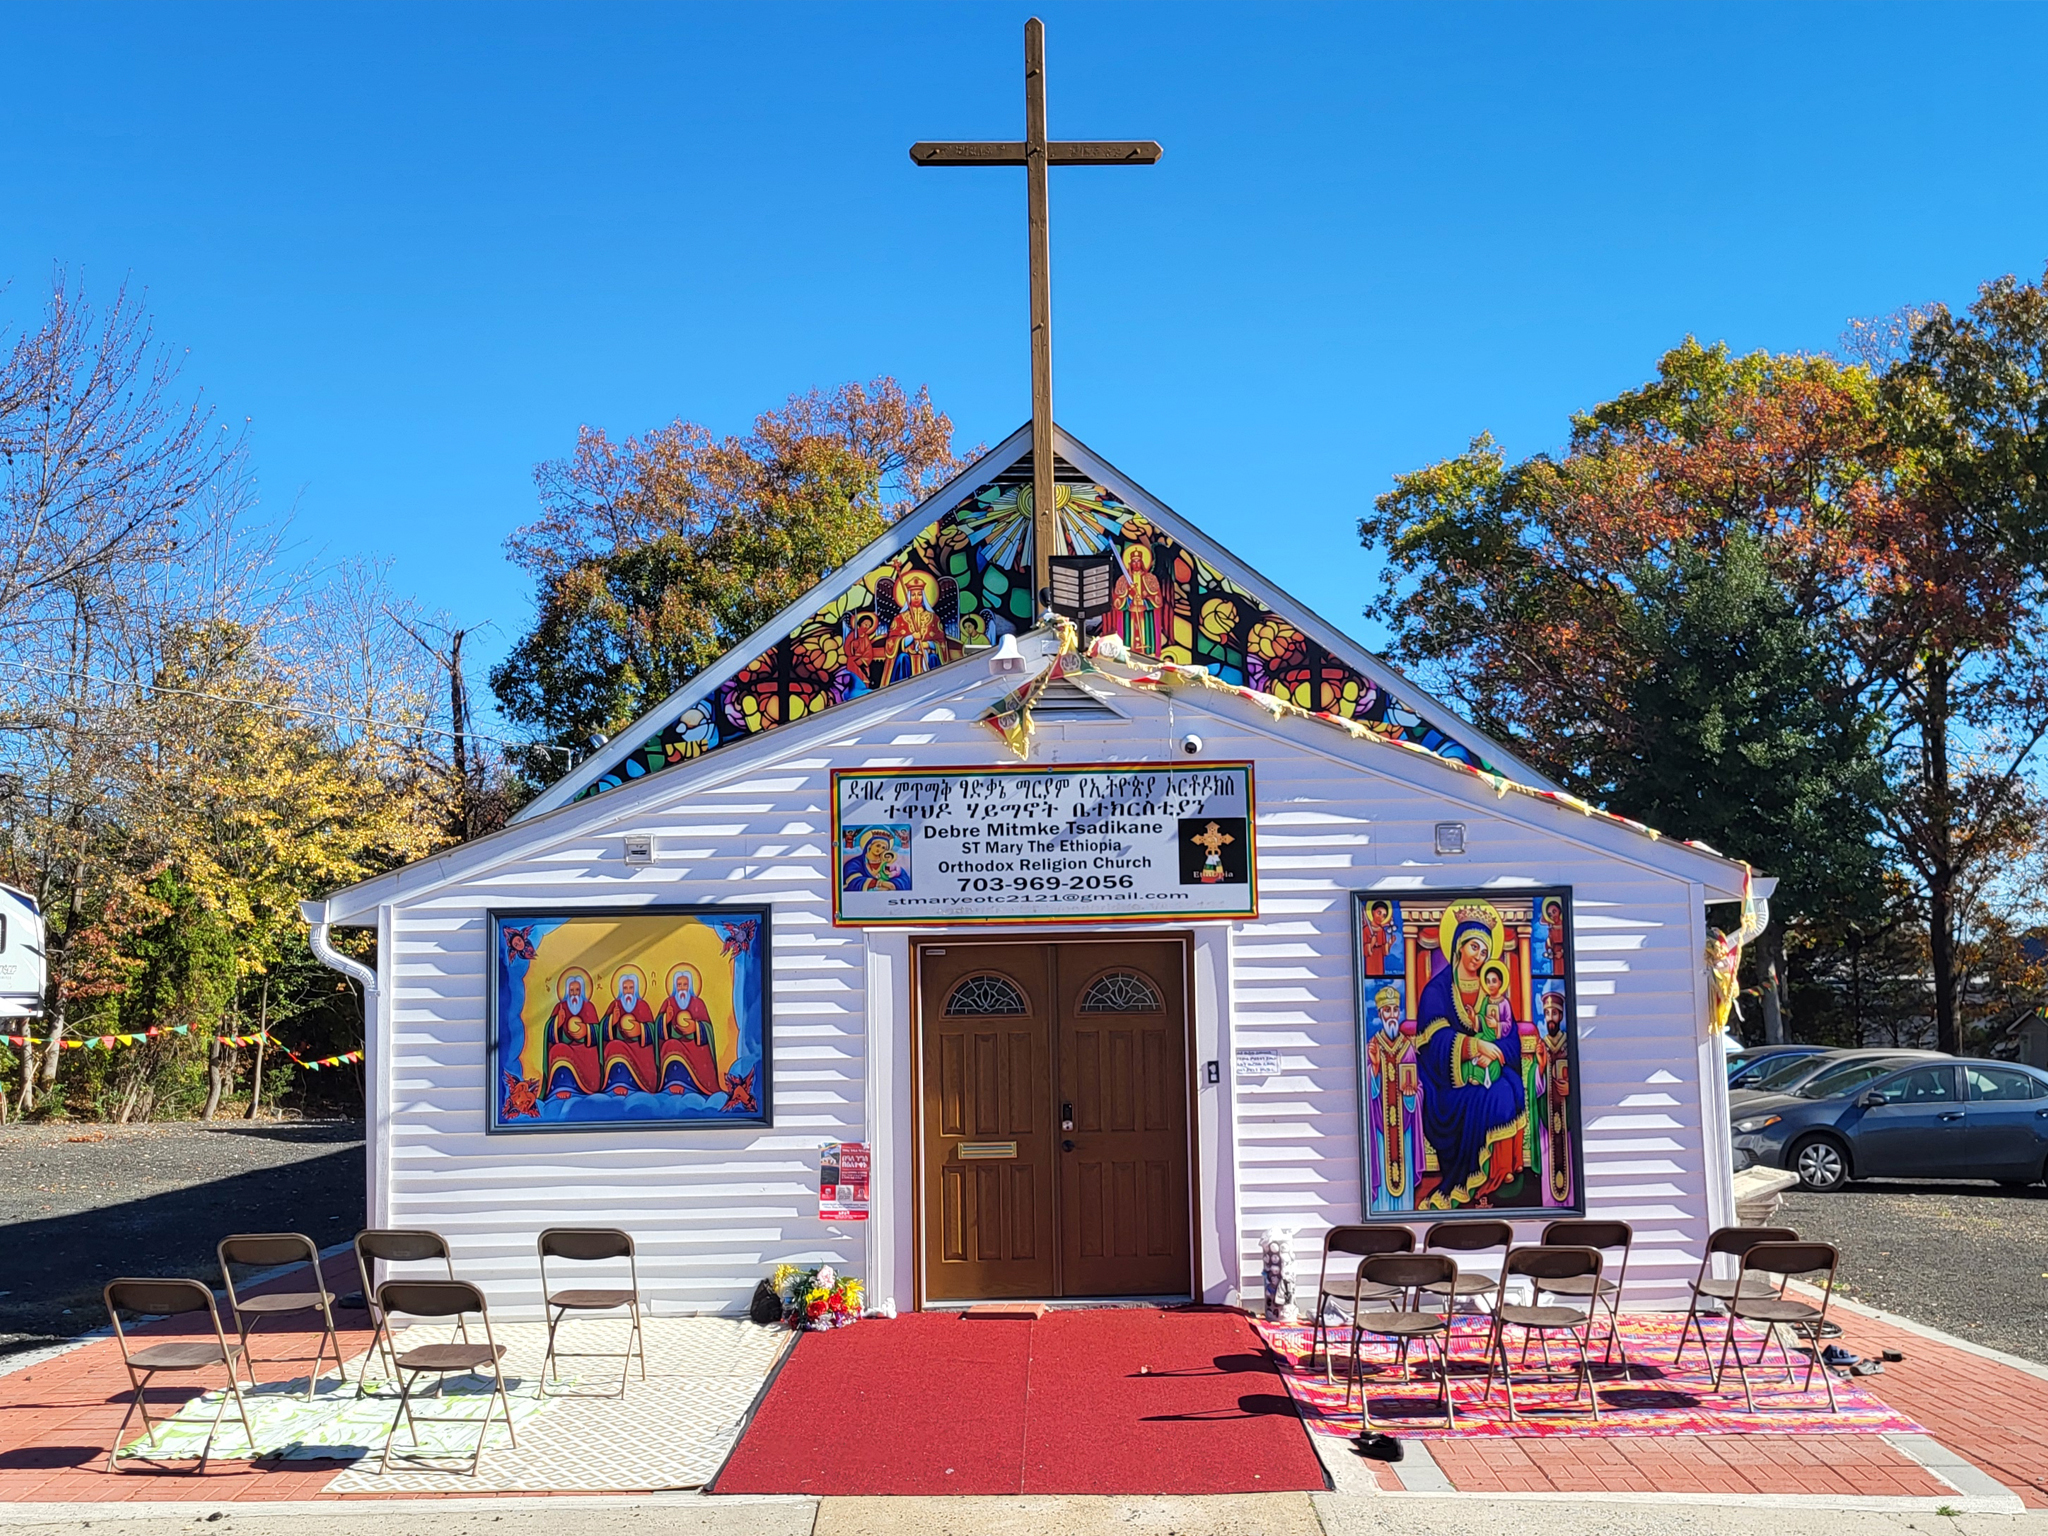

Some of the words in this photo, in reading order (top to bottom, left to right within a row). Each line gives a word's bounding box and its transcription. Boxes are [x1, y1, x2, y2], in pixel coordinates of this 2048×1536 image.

[847, 780, 885, 801] ደብረ
[893, 778, 952, 803] ምጥማቅ
[1015, 777, 1070, 800] ማርያም
[883, 802, 952, 819] ተዋህዶ
[924, 825, 981, 839] Debre
[987, 823, 1060, 837] Mitmke
[1066, 820, 1163, 835] Tsadikane
[961, 842, 981, 854] ST
[986, 841, 1023, 856] Mary
[1027, 840, 1055, 853] The
[1060, 839, 1122, 854] Ethiopia
[938, 860, 1014, 874] Orthodox
[1020, 858, 1088, 873] Religion
[1093, 856, 1152, 870] Church
[957, 875, 1134, 892] 703-969-2056
[888, 891, 1190, 907] stmaryeotc2121@gmail.com
